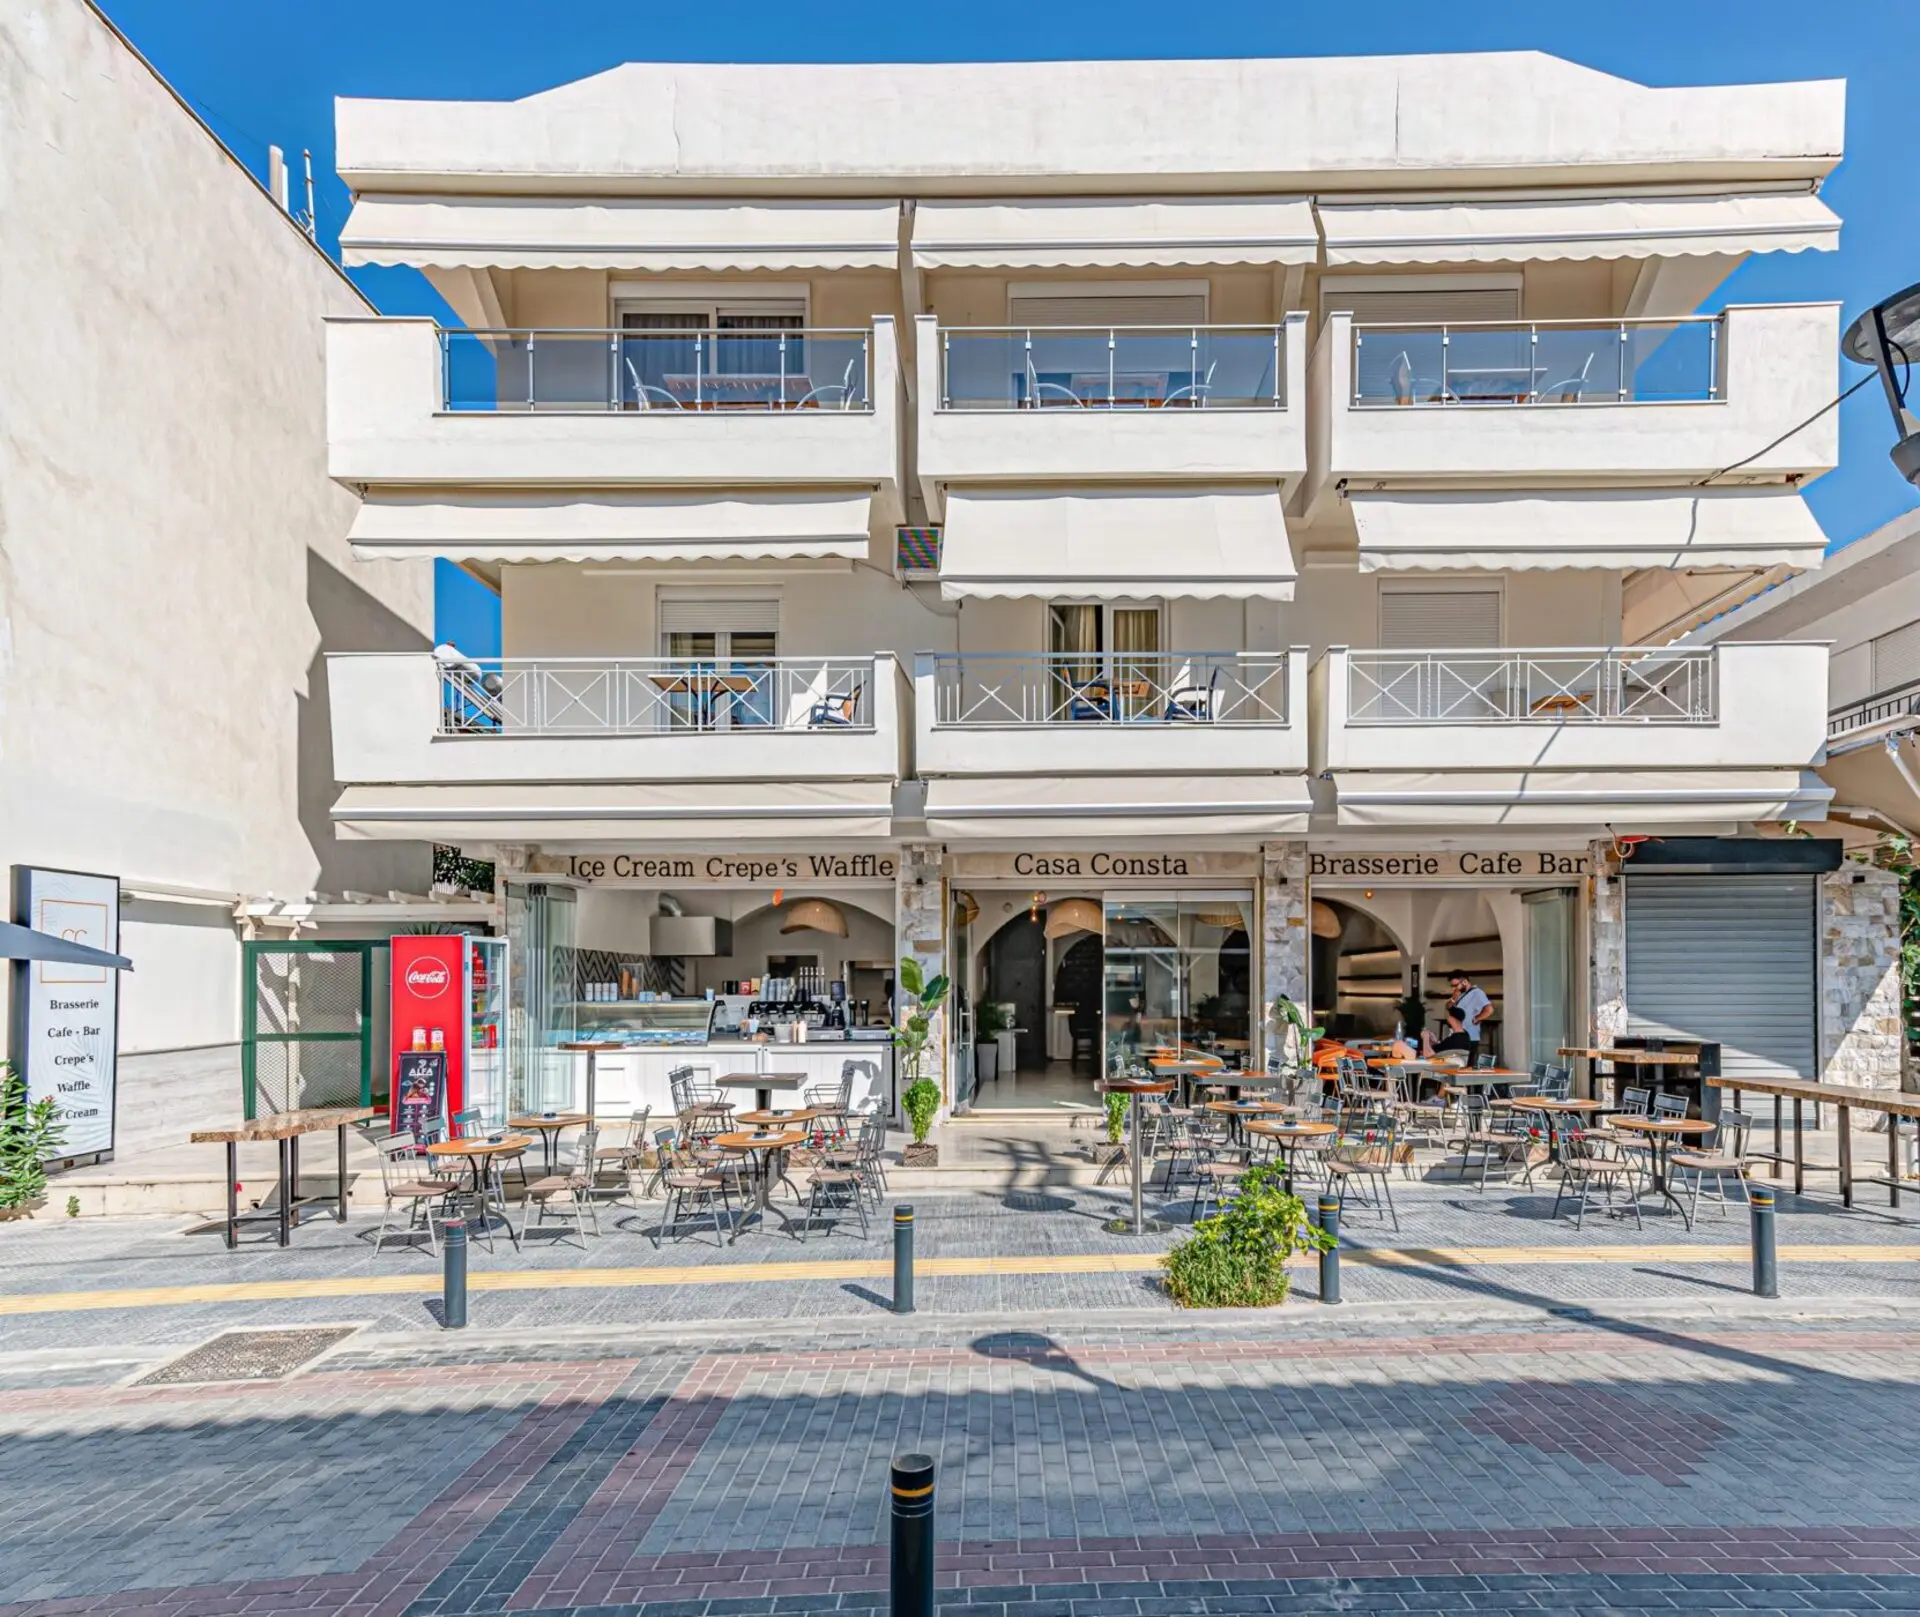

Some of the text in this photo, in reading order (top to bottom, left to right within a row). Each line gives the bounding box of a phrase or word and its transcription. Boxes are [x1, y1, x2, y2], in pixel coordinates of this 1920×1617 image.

[569, 854, 893, 881] Ice Cream Crepe's Waffle
[1014, 853, 1188, 875] Casa Consta
[1309, 852, 1588, 875] Brasserie Cafe Bar
[50, 999, 99, 1010] Brasserie
[47, 1026, 73, 1038] Cafe
[83, 1025, 101, 1036] Bar
[54, 1053, 94, 1066] Crepe's
[57, 1080, 91, 1093] Waffle
[65, 1108, 99, 1120] Cream
